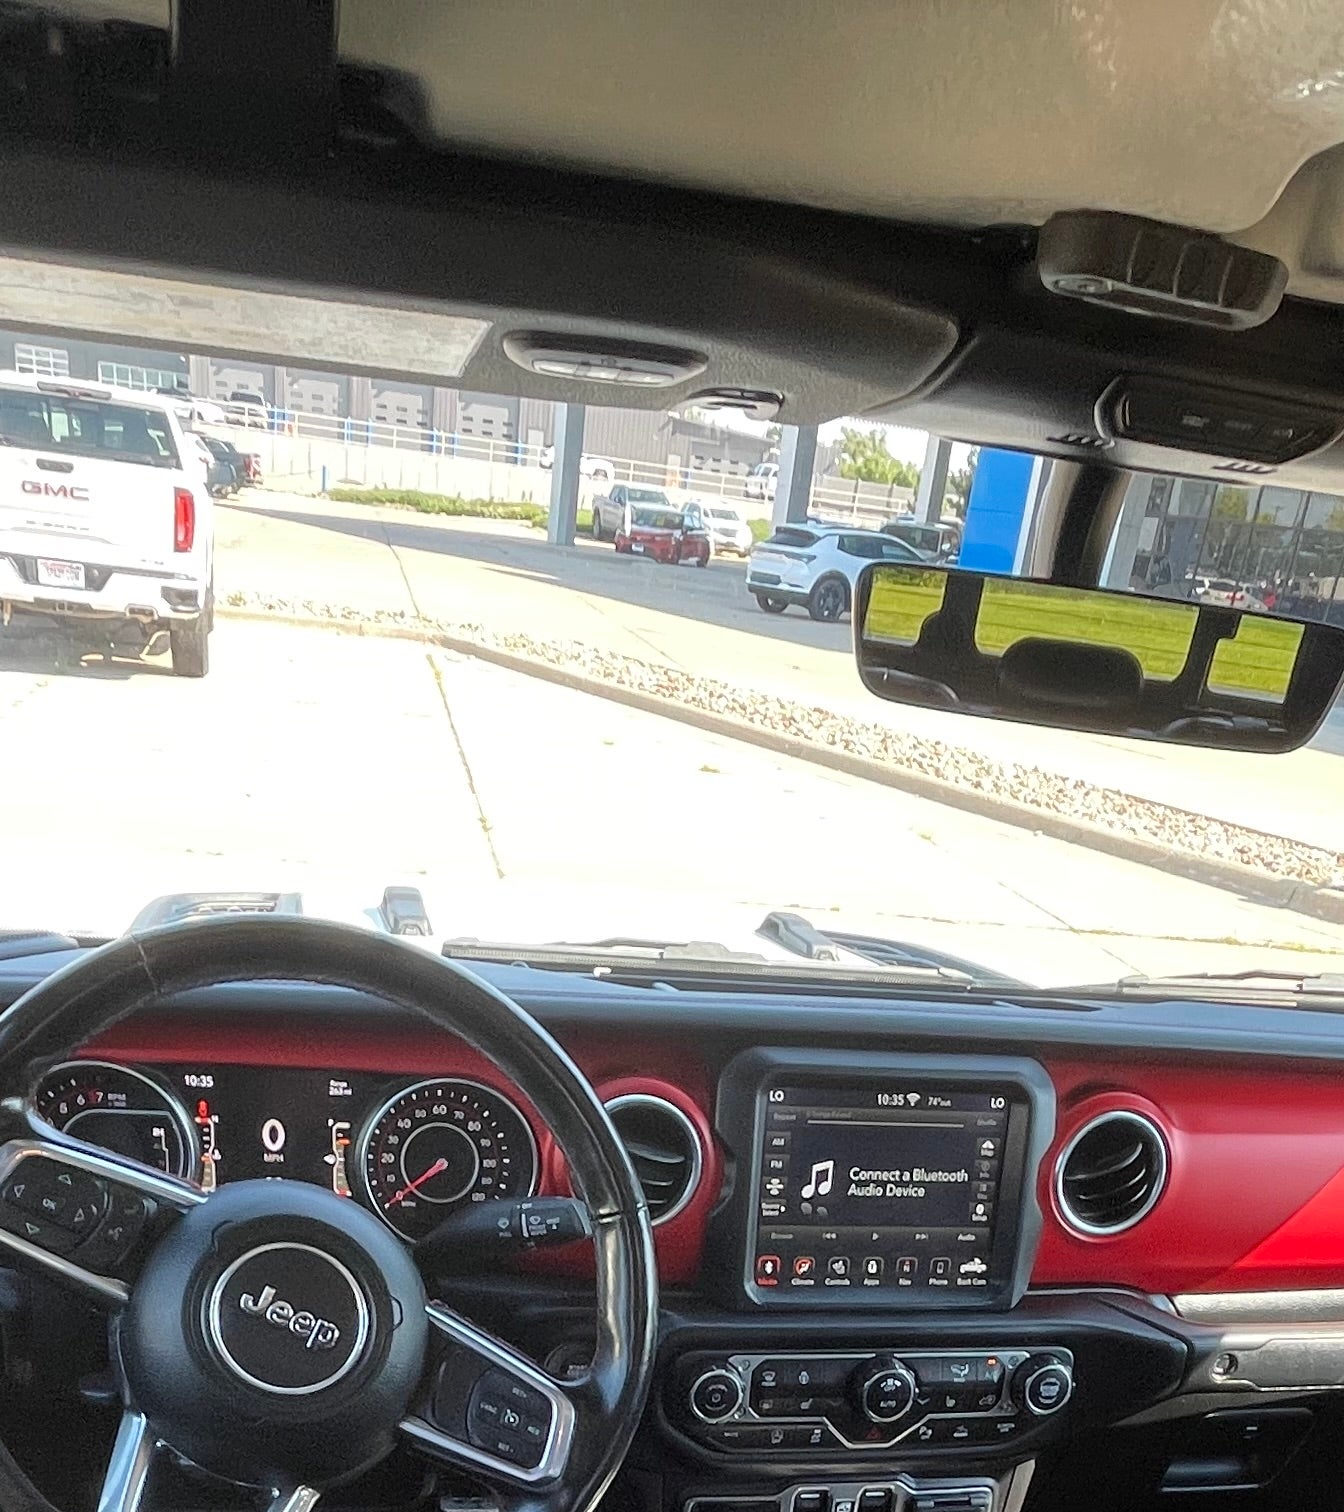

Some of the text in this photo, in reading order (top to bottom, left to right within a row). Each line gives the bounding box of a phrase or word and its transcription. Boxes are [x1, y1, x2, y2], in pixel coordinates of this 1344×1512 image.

[21, 480, 90, 501] GMC
[184, 1074, 214, 1087] 10:35
[96, 1092, 104, 1103] 7
[769, 1090, 784, 1102] LO
[877, 1093, 905, 1106] 10:35
[990, 1097, 1005, 1109] LO
[432, 1104, 447, 1115] 60
[261, 1118, 286, 1152] 0
[772, 1138, 785, 1146] AM
[263, 1153, 284, 1163] MPH
[381, 1153, 395, 1163] 20
[770, 1160, 783, 1168] FM
[849, 1167, 901, 1181] Connect
[902, 1170, 910, 1181] a
[912, 1168, 969, 1182] Bluetooth
[847, 1183, 926, 1197] Audio Device
[240, 1285, 341, 1349] Jeep
